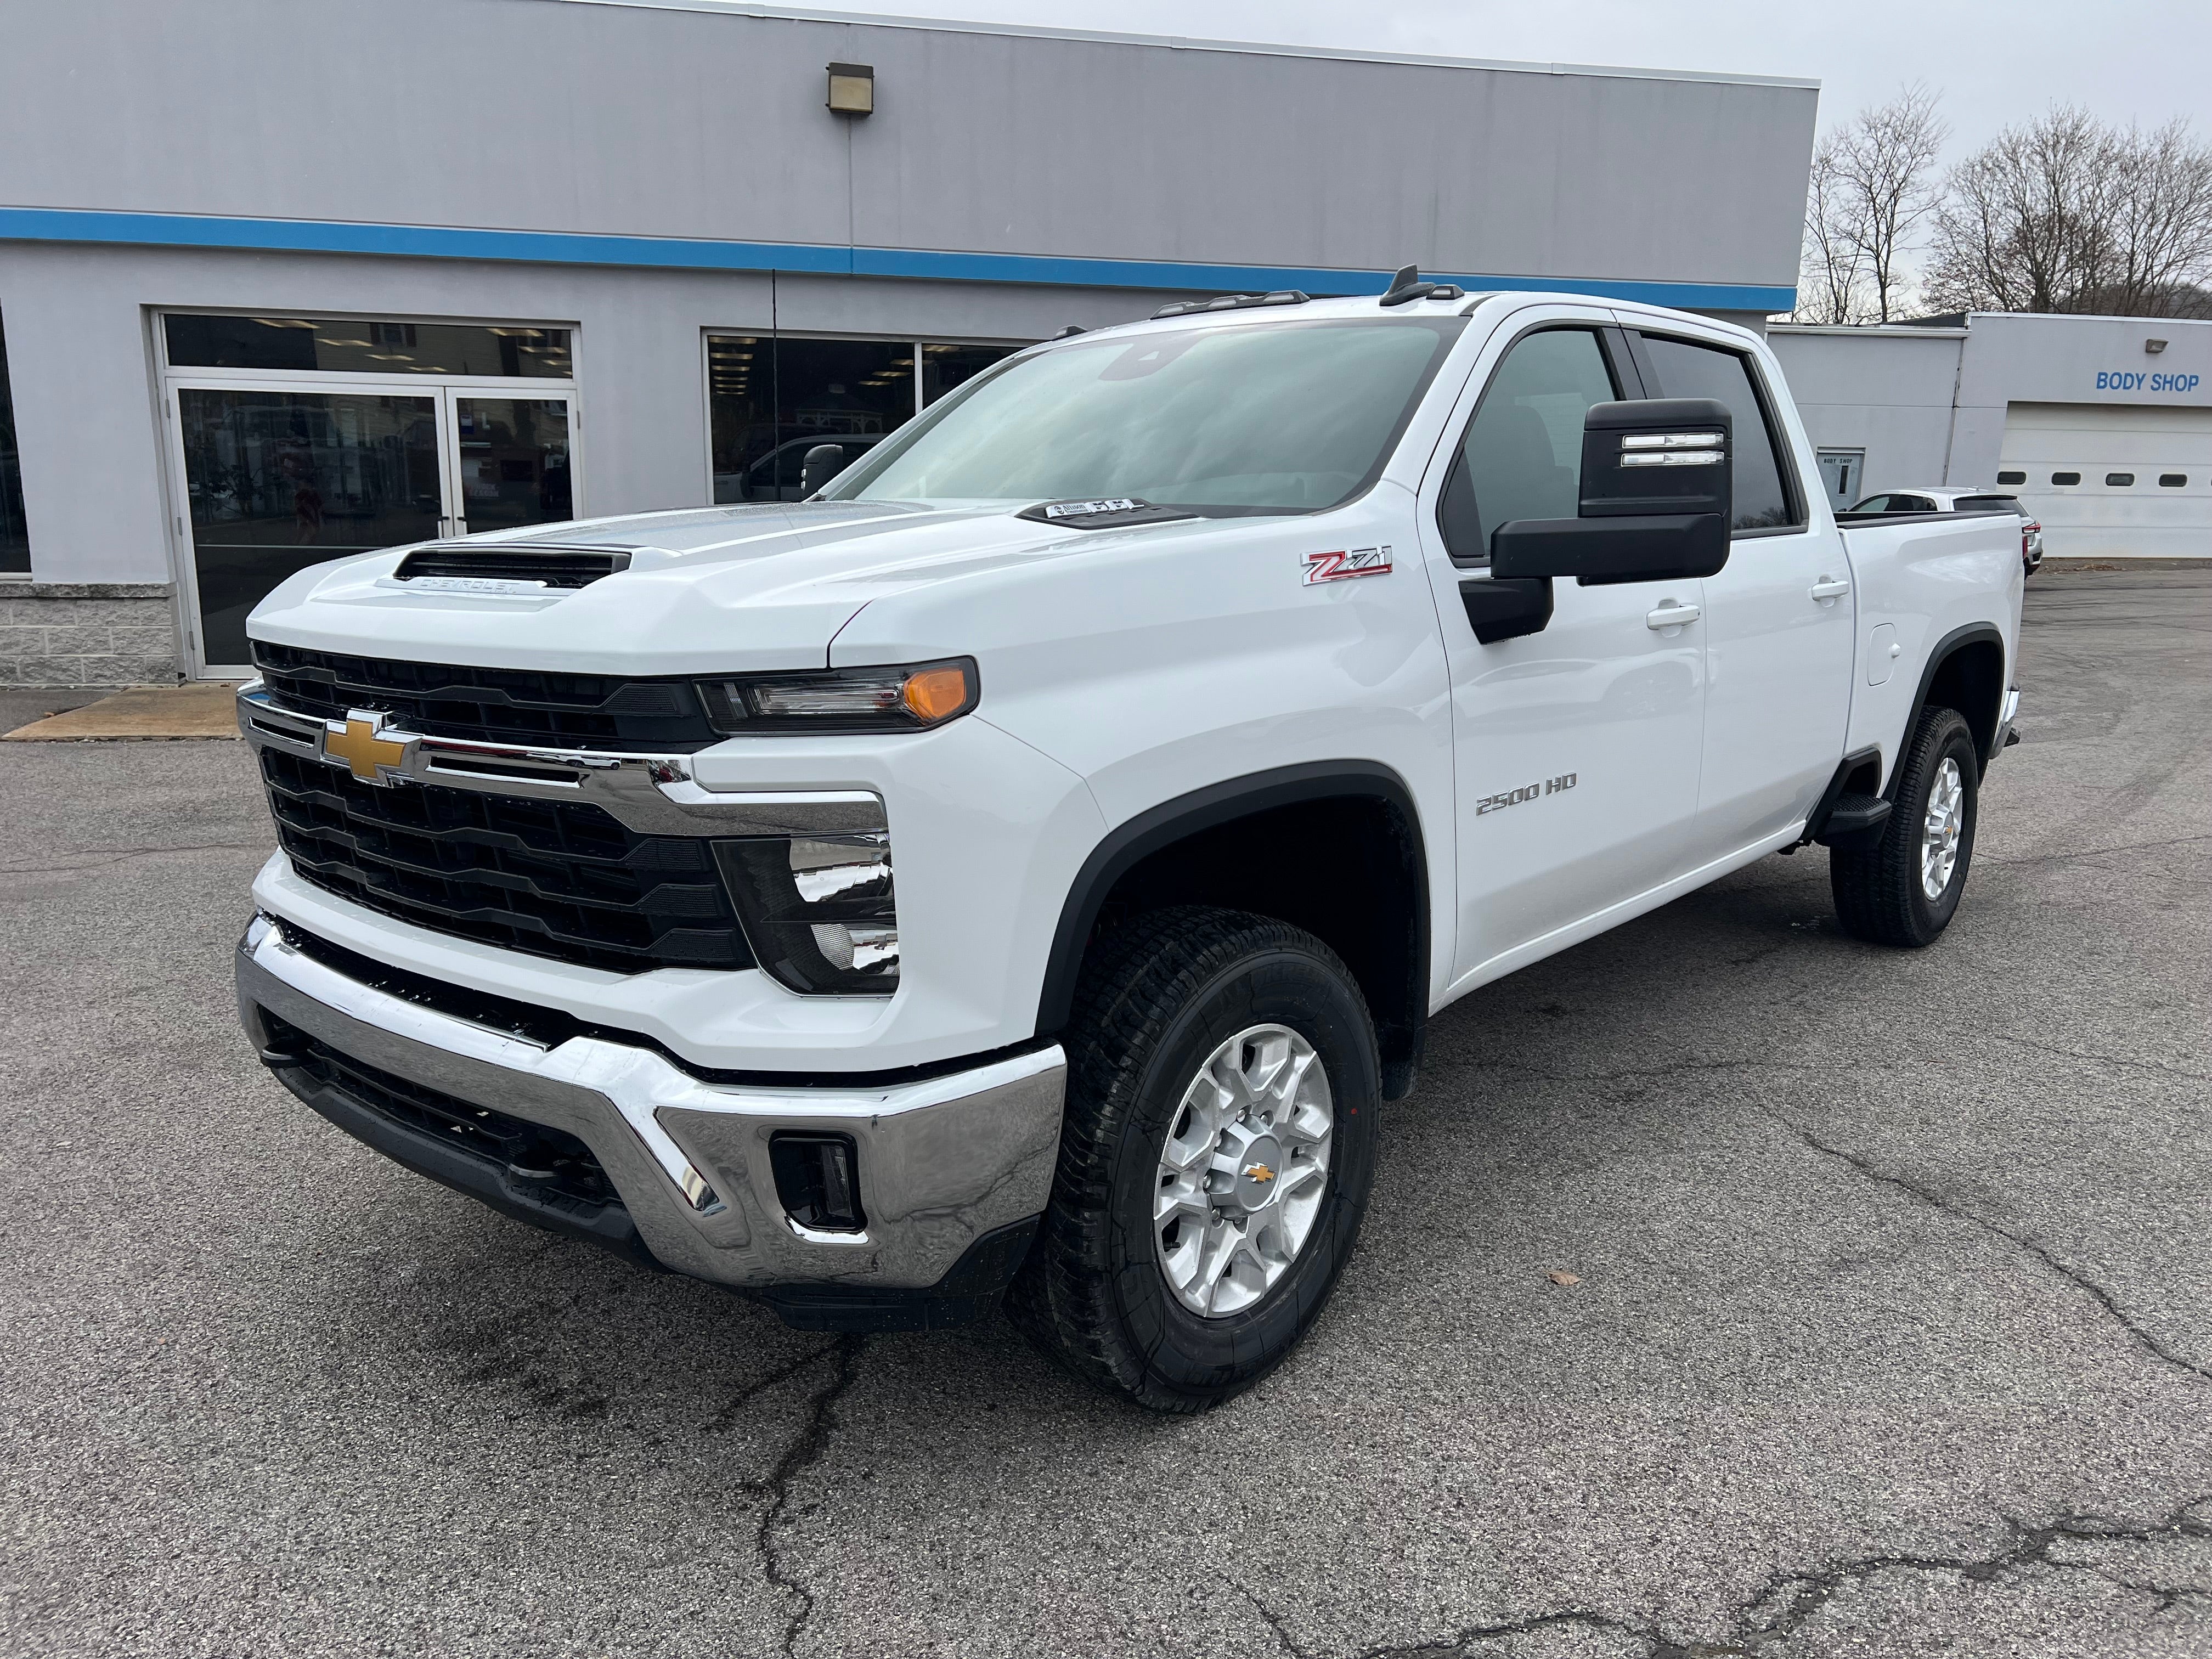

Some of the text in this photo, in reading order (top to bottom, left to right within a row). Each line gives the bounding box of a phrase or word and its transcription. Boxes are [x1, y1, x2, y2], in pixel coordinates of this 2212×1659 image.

[2096, 371, 2199, 392] BODY SHOP
[1300, 545, 1393, 586] Z71
[420, 579, 520, 591] CHEVROLET
[1476, 770, 1577, 816] 2500 HD
